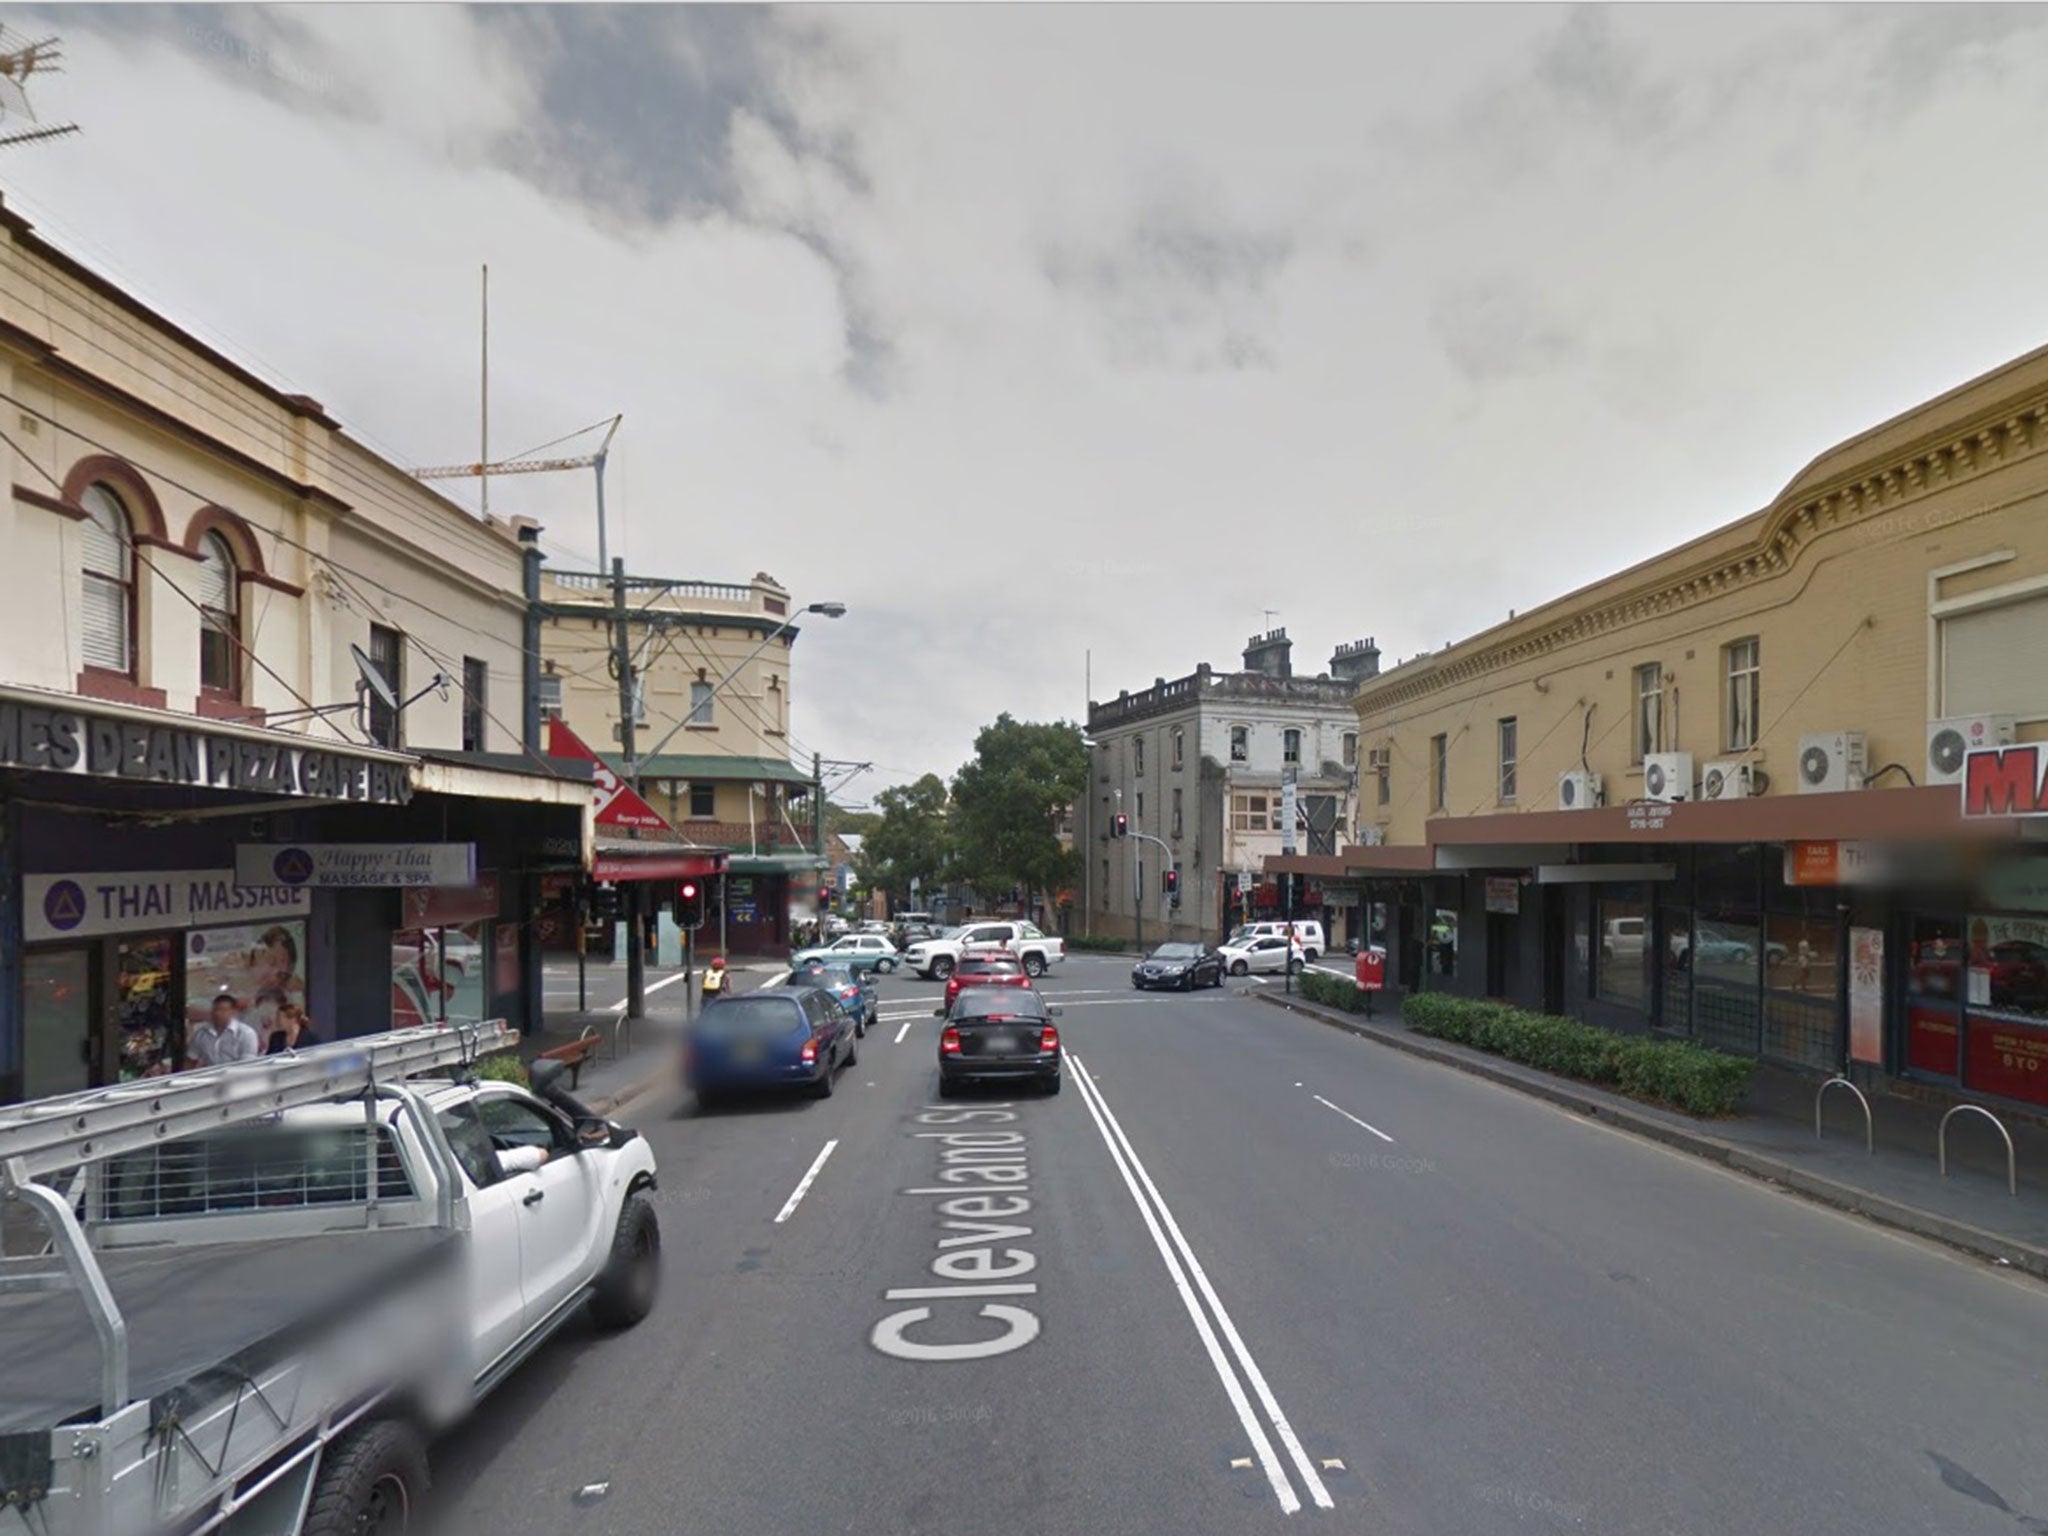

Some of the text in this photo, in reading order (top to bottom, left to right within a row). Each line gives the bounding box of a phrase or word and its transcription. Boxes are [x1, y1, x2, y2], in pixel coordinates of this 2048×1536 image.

[87, 717, 200, 784] DEAN
[207, 736, 297, 795] PIZZA
[301, 751, 367, 801] CAFE
[1963, 745, 2048, 817] M
[616, 813, 639, 825] Surry
[319, 850, 432, 872] Happy Thai
[318, 872, 432, 885] MASSAGE & SPA
[96, 879, 302, 920] THAI MASSAGE
